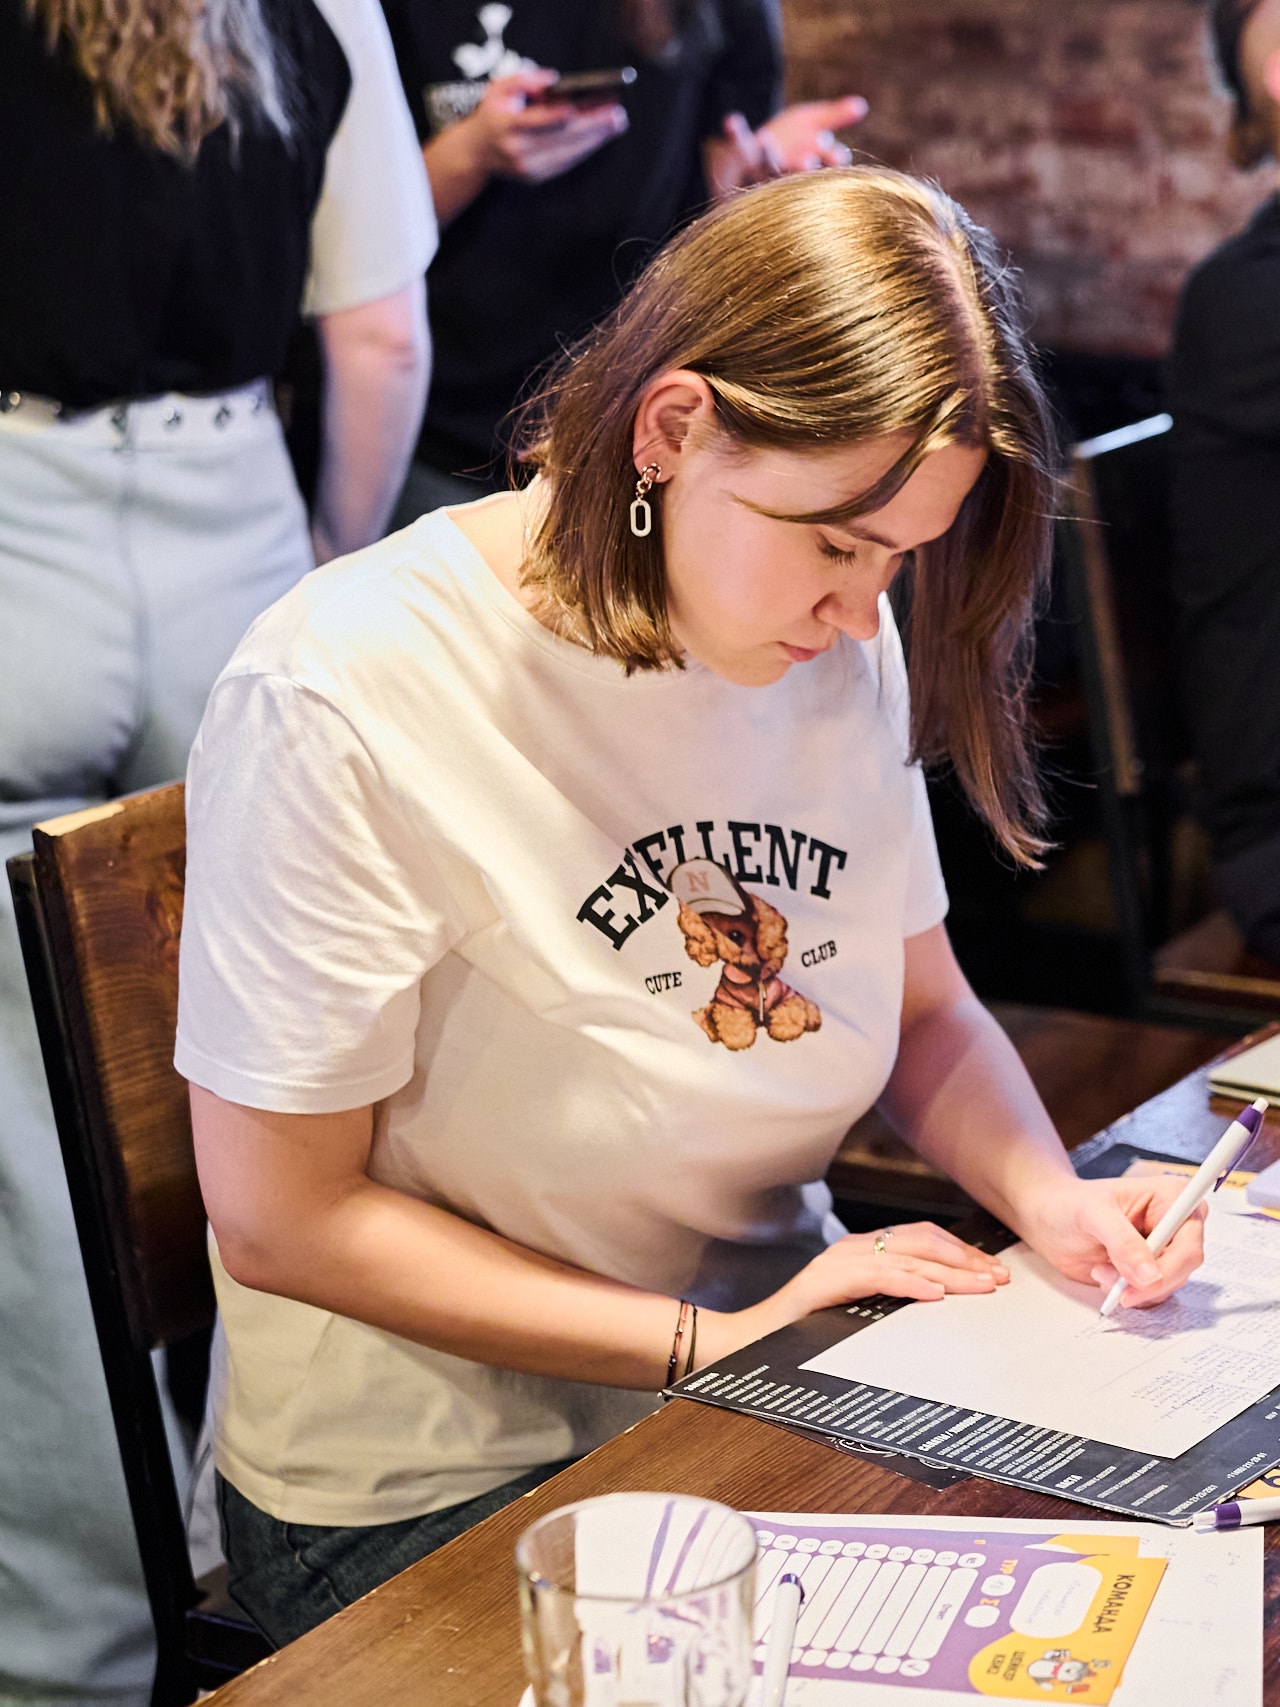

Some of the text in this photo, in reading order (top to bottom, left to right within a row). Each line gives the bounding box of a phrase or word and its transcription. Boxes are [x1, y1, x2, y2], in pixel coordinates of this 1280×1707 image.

[685, 871, 711, 893] N
[645, 940, 837, 995] CUTE CLUB
[1092, 1573, 1136, 1634] КОМАНДА
